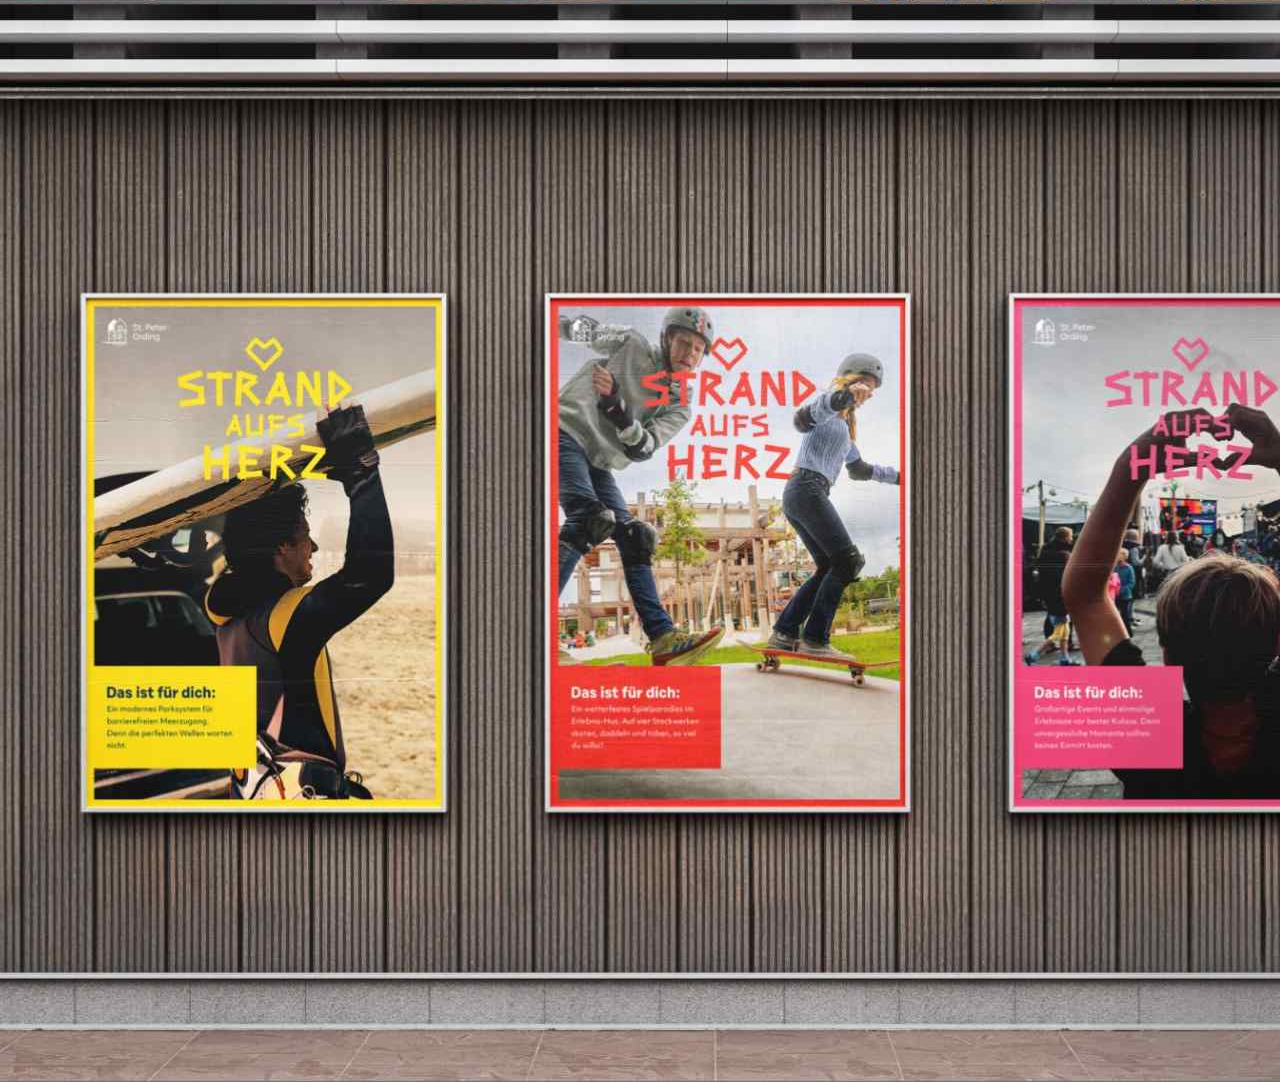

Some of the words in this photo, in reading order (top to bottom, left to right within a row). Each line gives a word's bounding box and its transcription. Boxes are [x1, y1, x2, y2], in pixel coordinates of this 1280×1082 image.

[177, 370, 353, 407] STRAND
[640, 370, 817, 408] STRAND
[1104, 370, 1279, 408] STRAND
[226, 413, 305, 438] AUFS
[690, 413, 769, 438] AUFS
[1152, 413, 1232, 438] AUFS
[202, 444, 328, 481] HERZ
[667, 444, 792, 481] HERZ
[1129, 444, 1254, 481] HERZ
[106, 686, 132, 699] Das
[136, 686, 154, 699] ist
[157, 686, 178, 699] für
[181, 686, 216, 699] dich:
[570, 686, 597, 699] Das
[600, 686, 618, 699] ist
[622, 686, 643, 699] für
[646, 686, 680, 699] dich:
[1033, 686, 1060, 699] Das
[1063, 686, 1082, 699] ist
[1085, 686, 1106, 699] für
[1108, 686, 1143, 699] dich:
